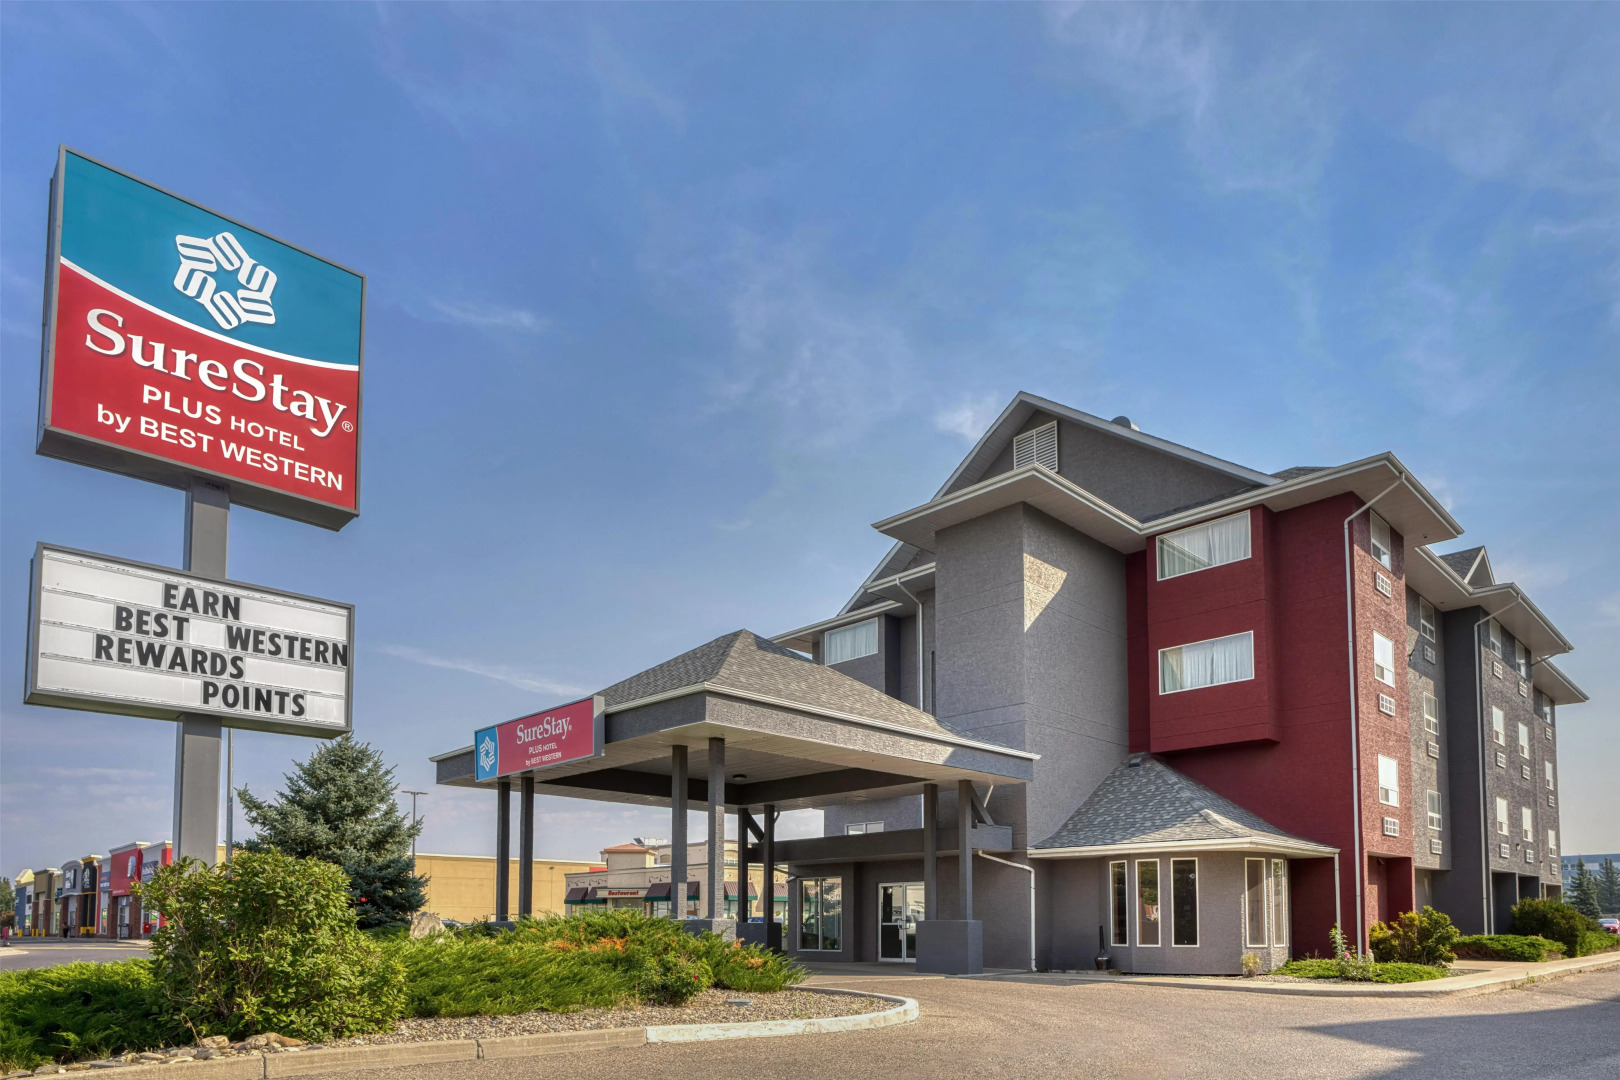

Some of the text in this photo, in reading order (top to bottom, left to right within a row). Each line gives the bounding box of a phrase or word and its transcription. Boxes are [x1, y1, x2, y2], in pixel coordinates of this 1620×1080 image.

[142, 384, 305, 451] PLUS HOTEL
[97, 404, 343, 491] by BEST WESTERN
[163, 582, 241, 621] EARN
[95, 633, 244, 680] REWARDS
[114, 605, 348, 667] BEST WESTERN
[202, 681, 306, 717] POINTS
[529, 742, 557, 754] PLUS HOTEL
[542, 752, 562, 762] WESTERN
